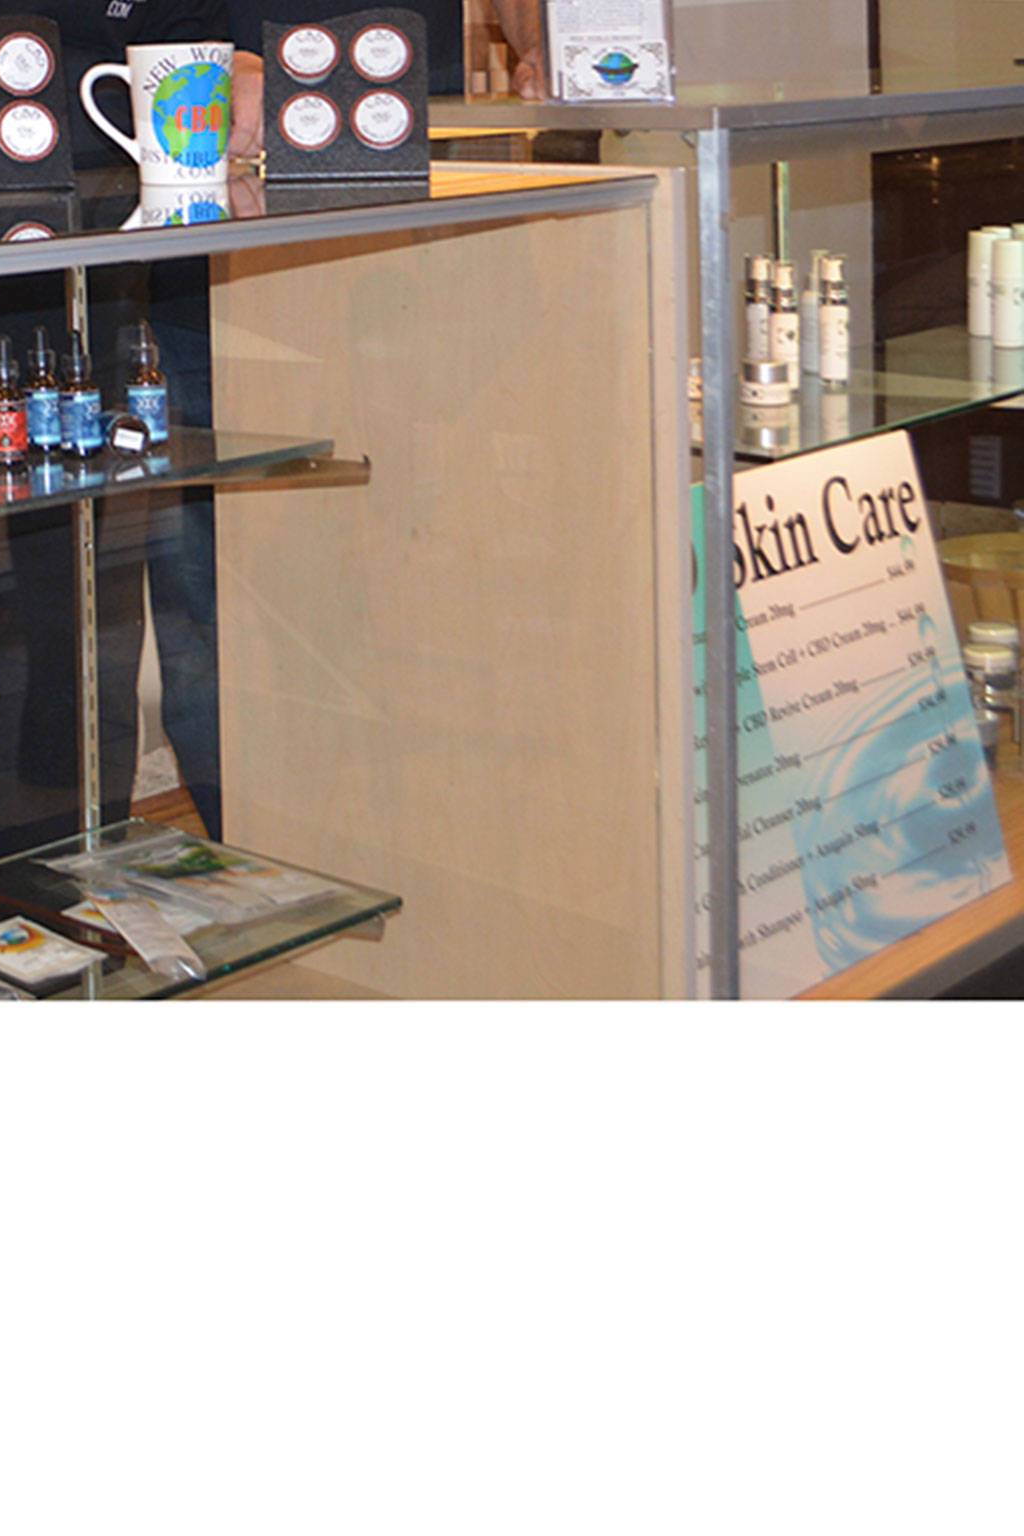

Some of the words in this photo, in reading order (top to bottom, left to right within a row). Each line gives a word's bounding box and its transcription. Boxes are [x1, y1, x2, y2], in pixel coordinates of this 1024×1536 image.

[143, 54, 176, 96] NEW
[175, 104, 223, 133] CBD
[822, 474, 921, 555] Care
[832, 629, 862, 648] Cream
[801, 689, 833, 710] Cream
